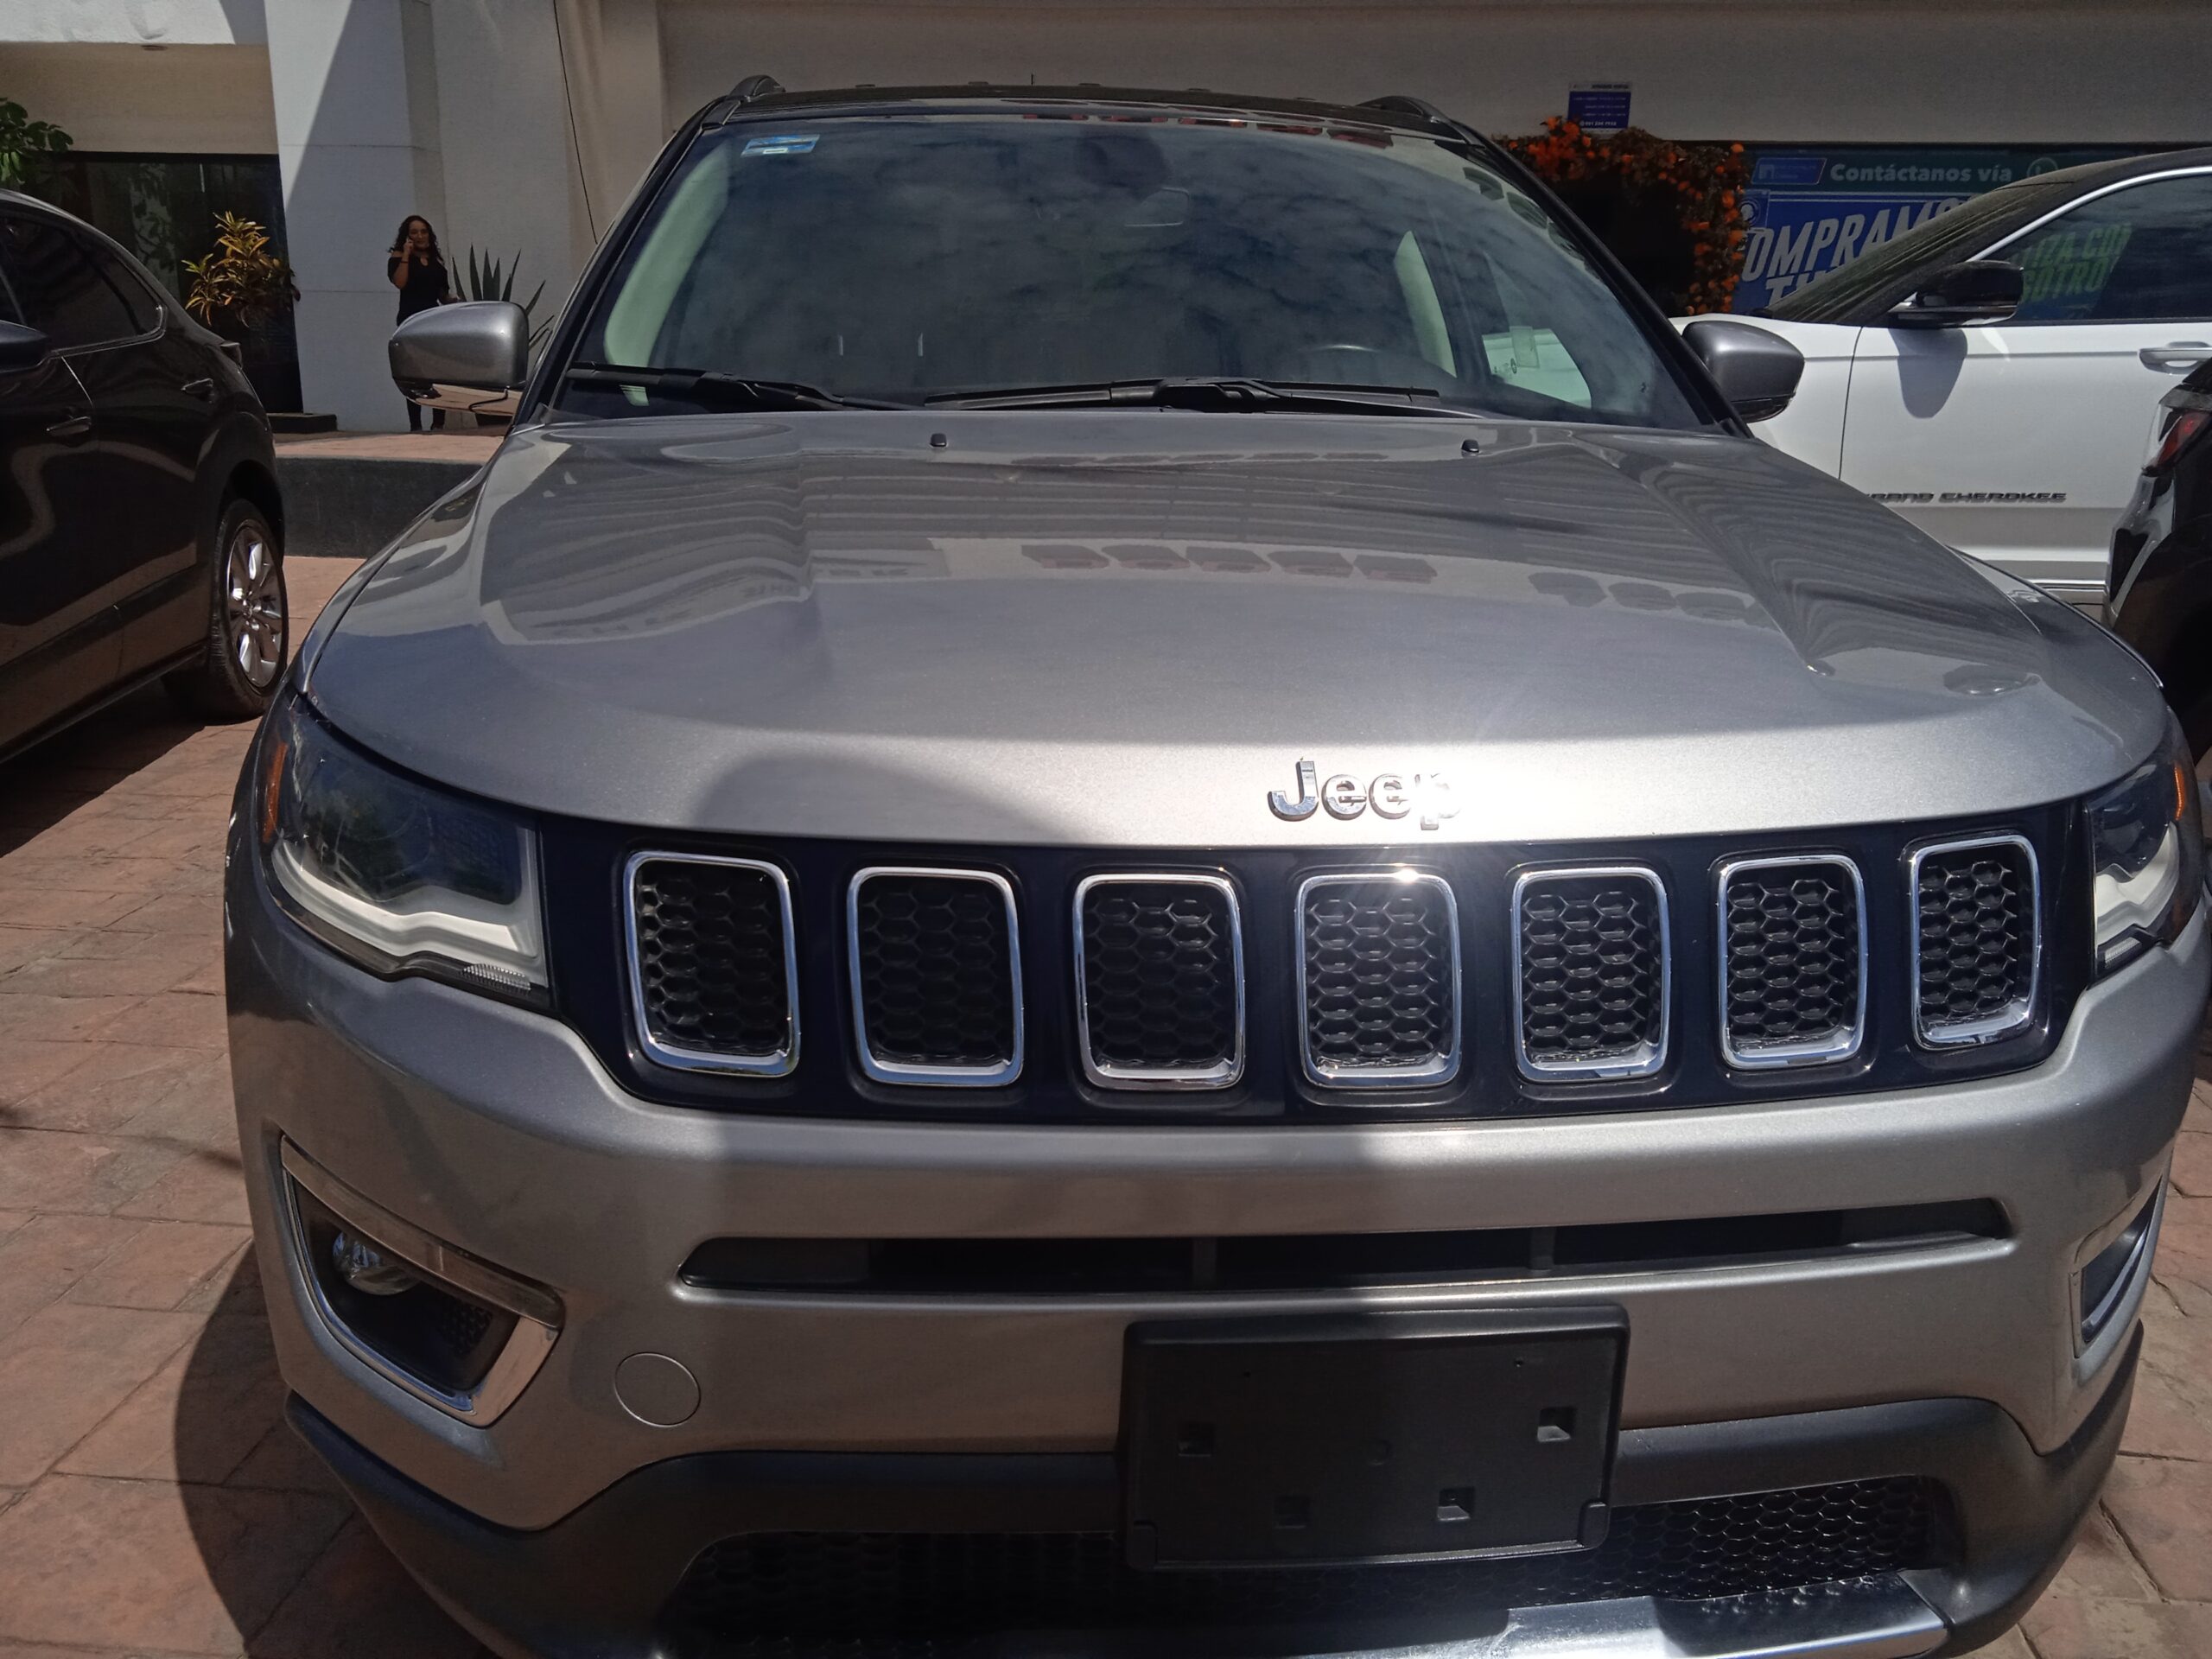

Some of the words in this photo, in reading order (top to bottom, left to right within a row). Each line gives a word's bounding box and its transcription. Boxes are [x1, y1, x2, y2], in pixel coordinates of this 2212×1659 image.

[1829, 162, 1972, 182] Contáctanos
[1978, 162, 2012, 182] vía
[1740, 195, 1985, 283] OMPRAM
[1865, 493, 1935, 504] RAND
[1940, 493, 2068, 504] CHEROKEE
[1267, 759, 1461, 831] Jeep
